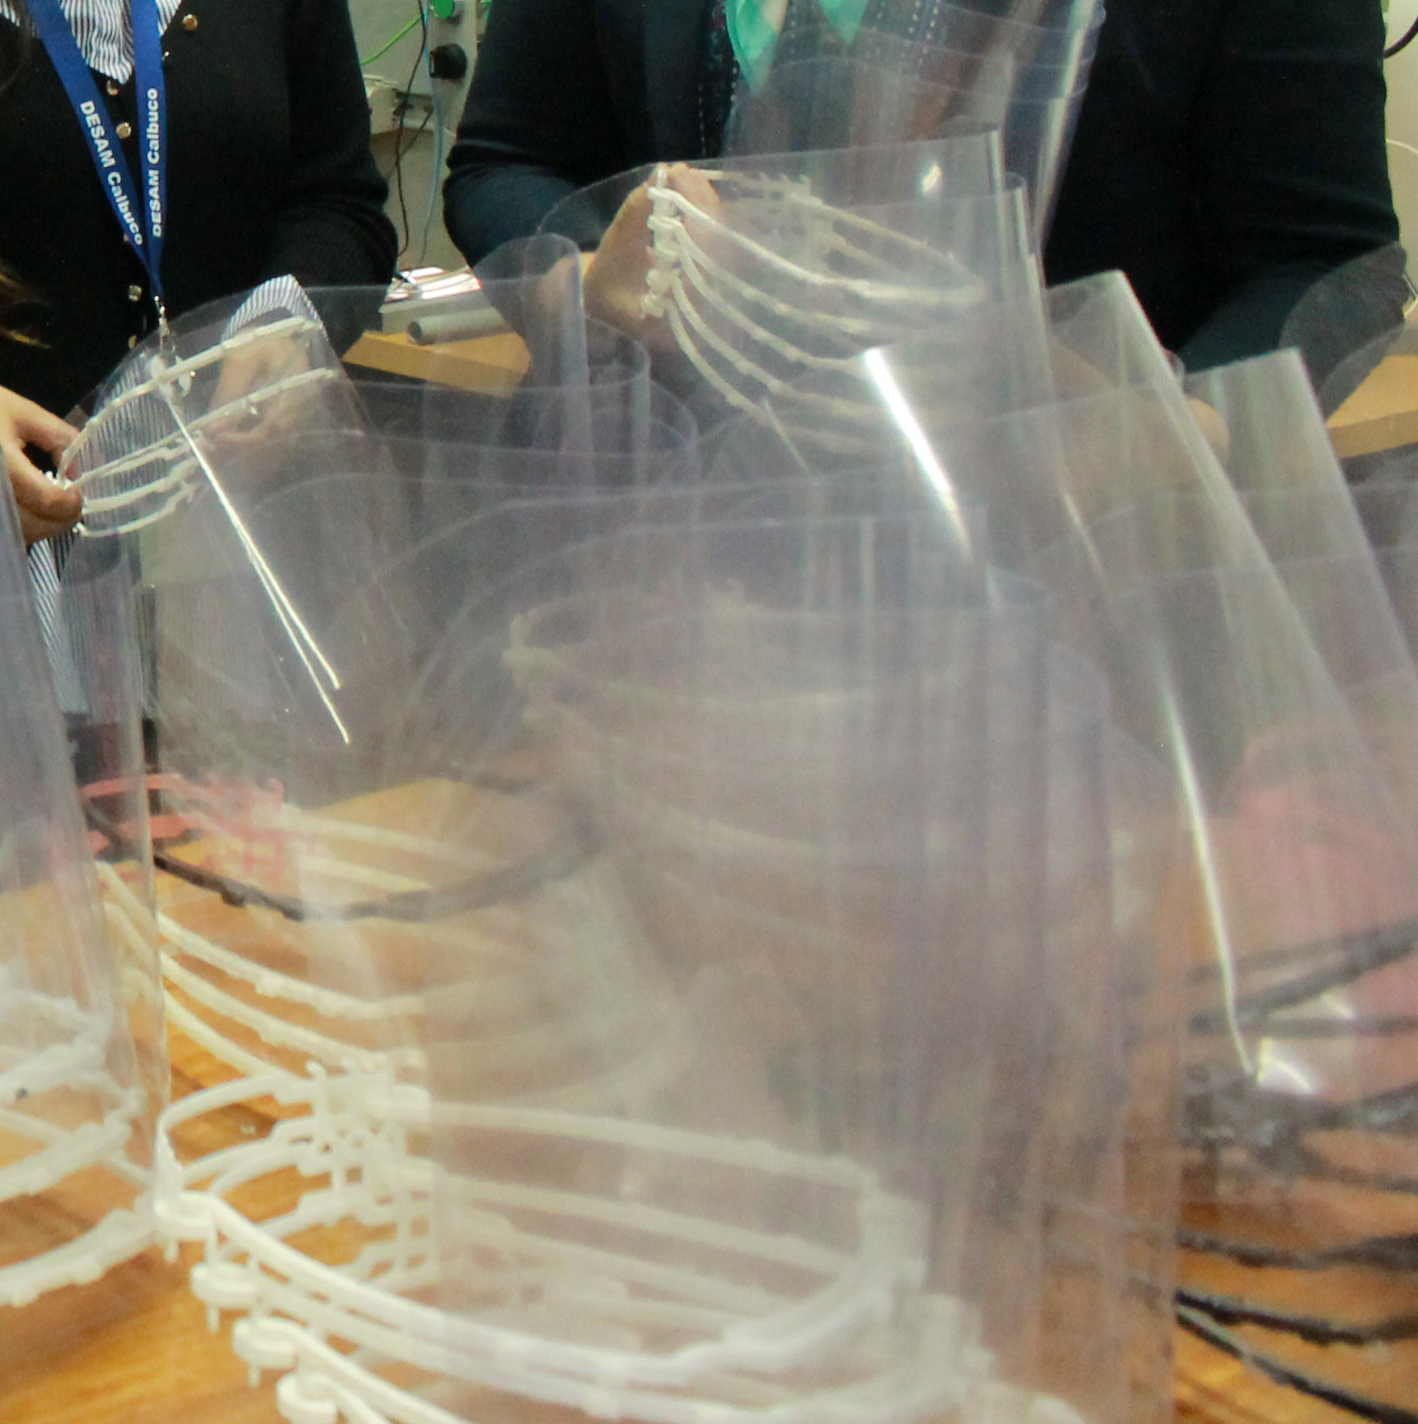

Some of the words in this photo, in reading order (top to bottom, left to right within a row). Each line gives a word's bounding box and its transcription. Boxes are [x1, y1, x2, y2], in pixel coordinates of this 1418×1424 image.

[146, 87, 160, 165] Calbuco
[79, 99, 117, 169] DESAM
[107, 171, 144, 246] Calbuco
[148, 169, 162, 238] DESAM
